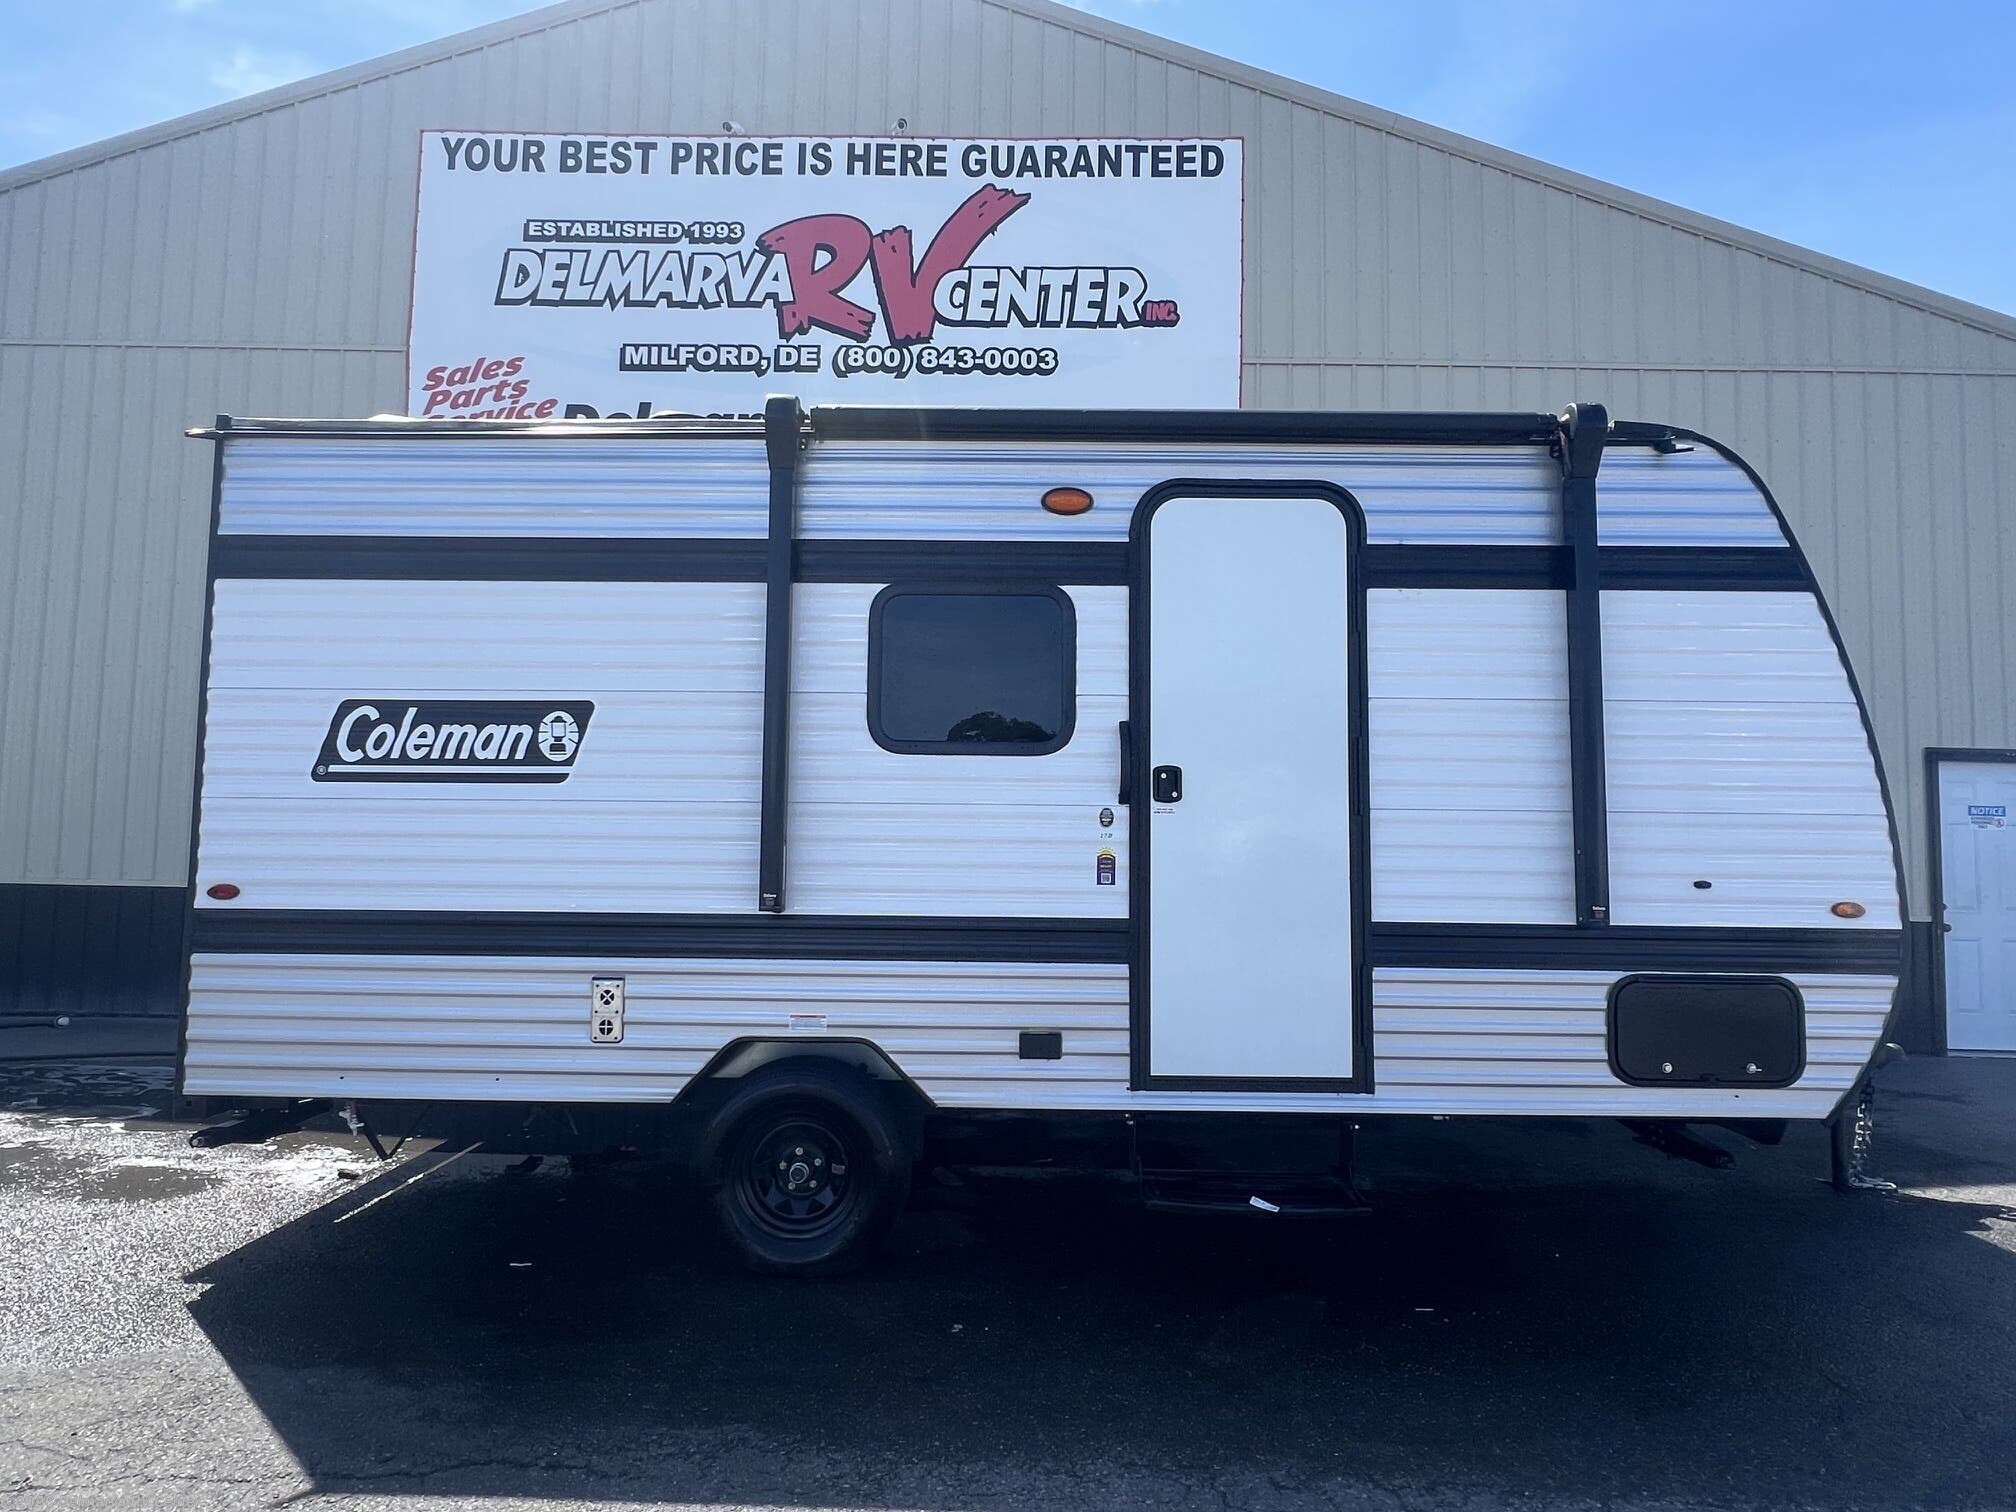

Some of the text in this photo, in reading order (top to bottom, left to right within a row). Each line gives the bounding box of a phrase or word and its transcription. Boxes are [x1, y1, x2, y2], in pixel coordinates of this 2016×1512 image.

[441, 138, 1224, 178] YOUR BEST PRICE IS HERE GUARANTEED
[525, 220, 745, 243] ESTABLISHED 1993
[495, 248, 797, 310] DELMARVA
[756, 183, 1031, 346] RV
[932, 266, 1147, 328] CENTER
[422, 357, 525, 391] Sales
[620, 344, 1058, 378] MILFORD, DE (800) 843-0003
[423, 379, 530, 415] Parts
[428, 398, 559, 419] vice
[336, 705, 533, 762] Coleman
[1970, 806, 2004, 816] NOTICE
